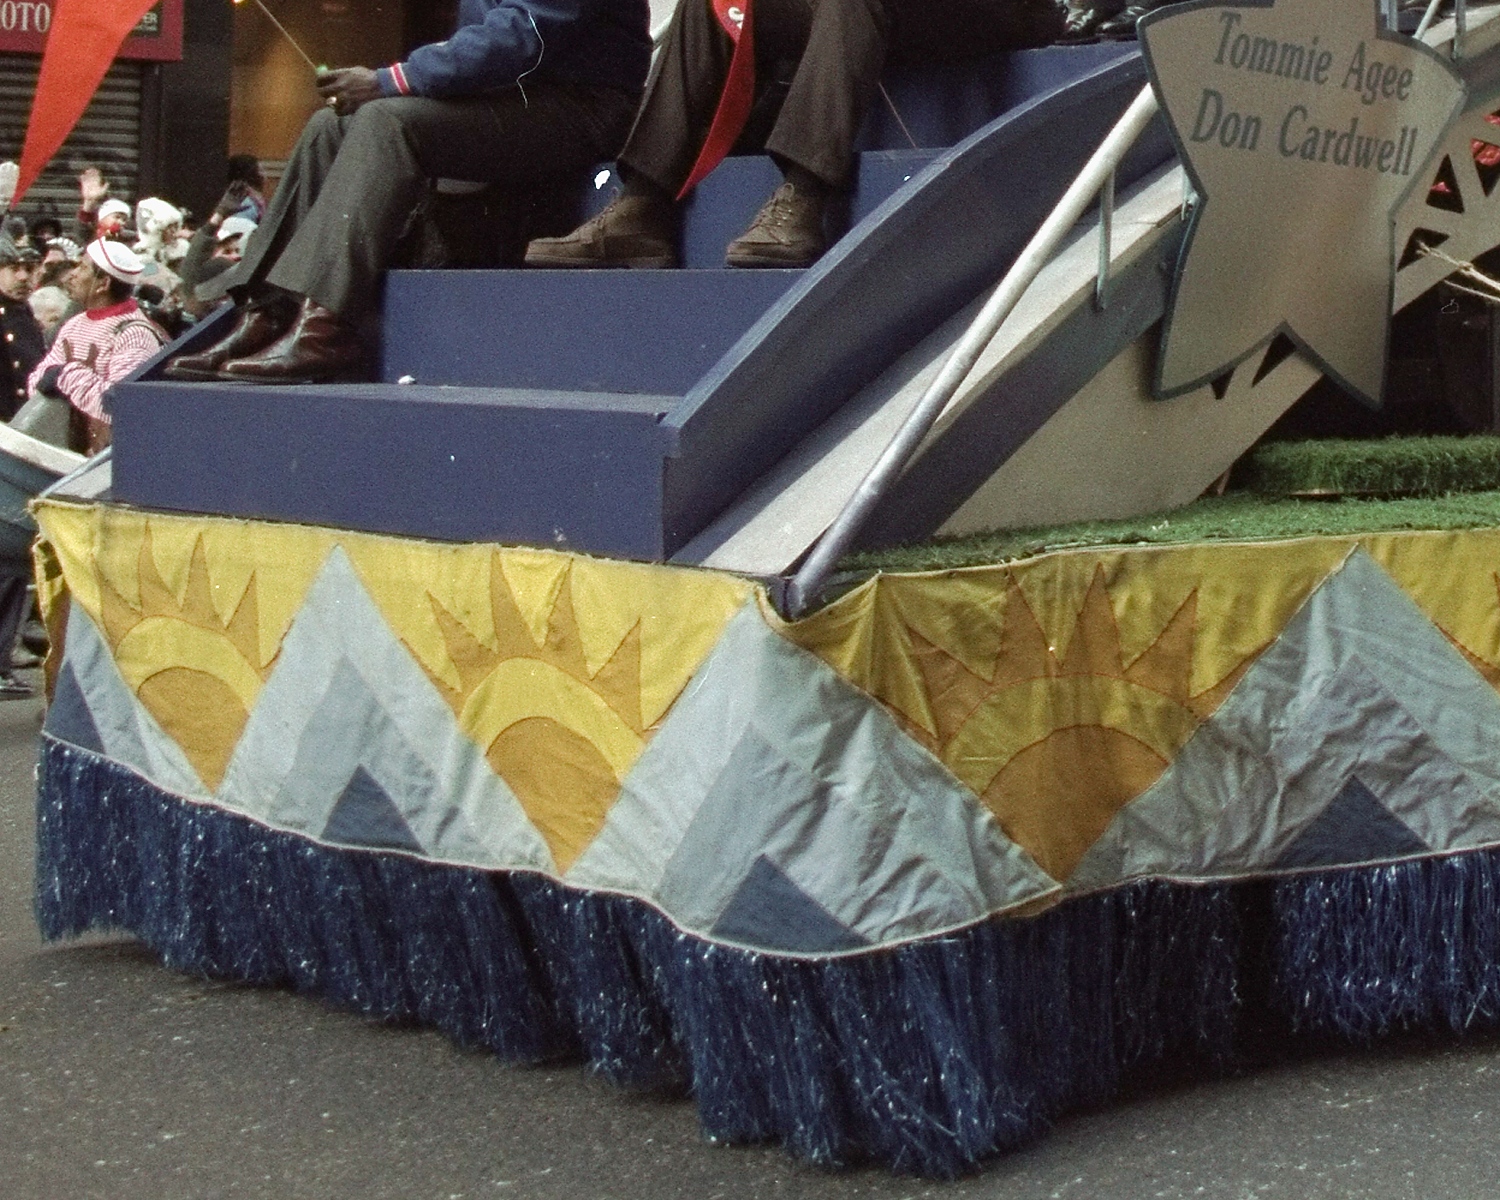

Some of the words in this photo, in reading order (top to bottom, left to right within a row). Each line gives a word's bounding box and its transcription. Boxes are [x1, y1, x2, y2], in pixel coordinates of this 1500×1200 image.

[1213, 10, 1333, 85] Tommie
[1341, 40, 1415, 106] Agee
[1189, 87, 1263, 151] Don
[1278, 104, 1419, 176] Cardwell
